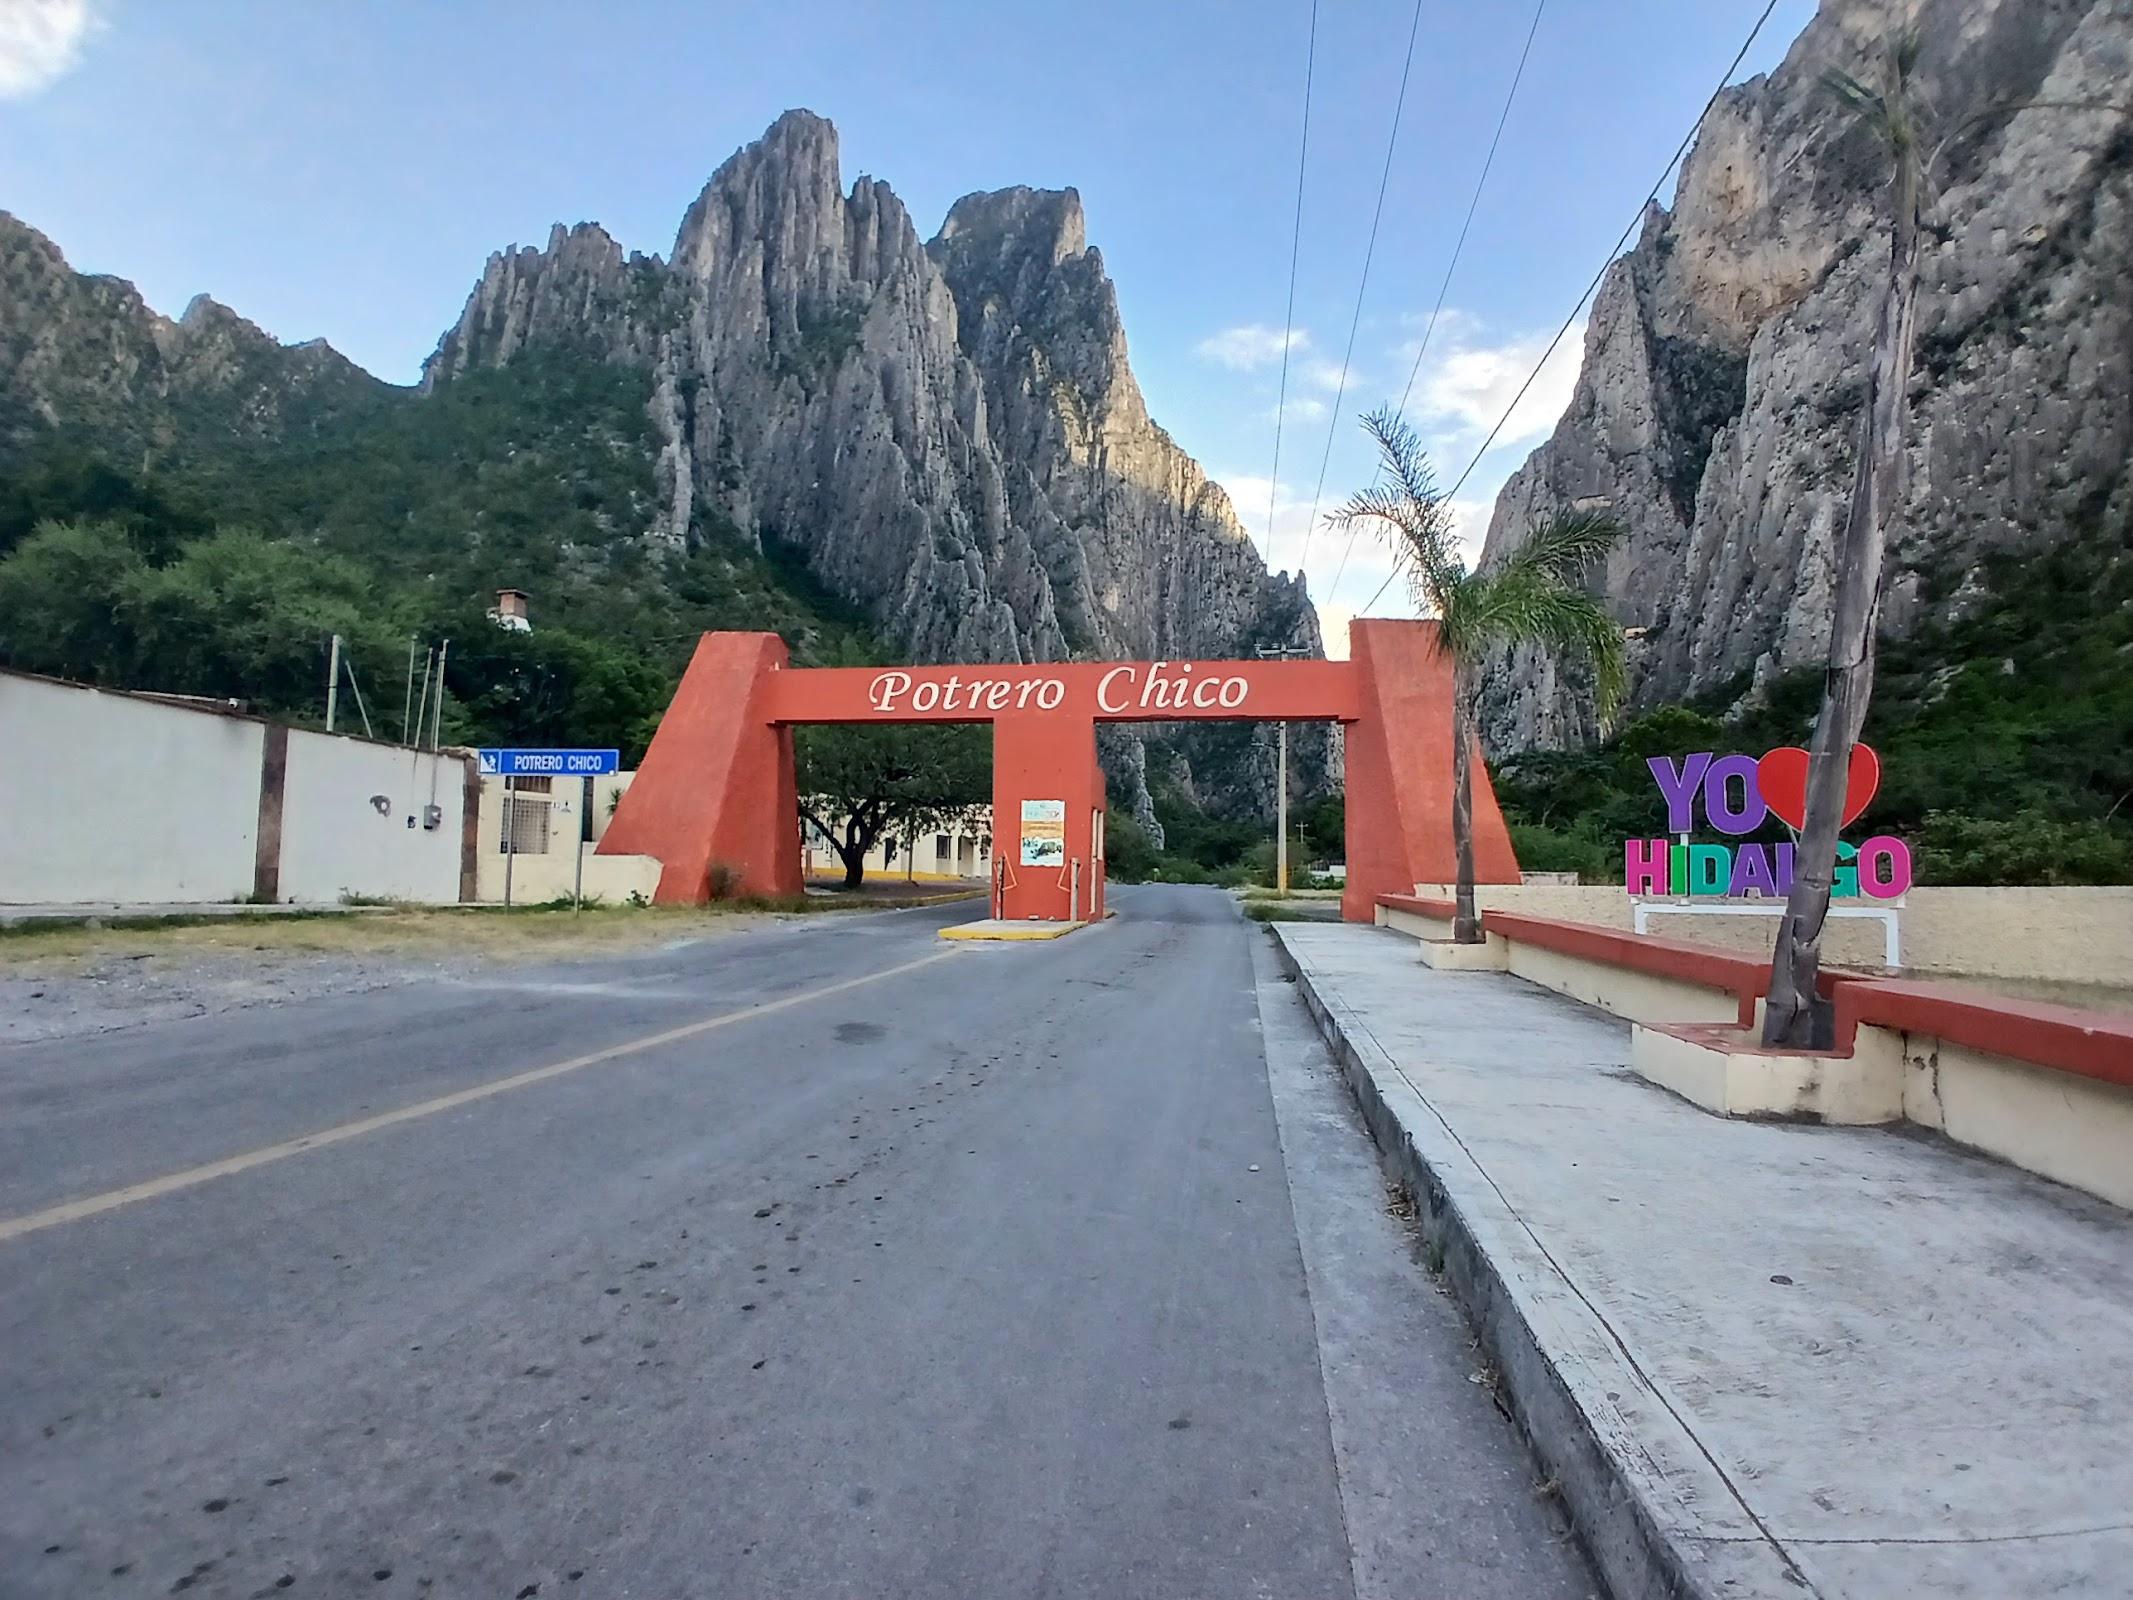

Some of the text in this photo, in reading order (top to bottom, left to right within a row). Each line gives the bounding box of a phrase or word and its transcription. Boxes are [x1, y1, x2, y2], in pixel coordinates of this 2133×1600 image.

[869, 662, 1250, 713] Potrero Chico
[514, 755, 602, 771] POTRERO CHICO
[1646, 752, 1768, 835] YO
